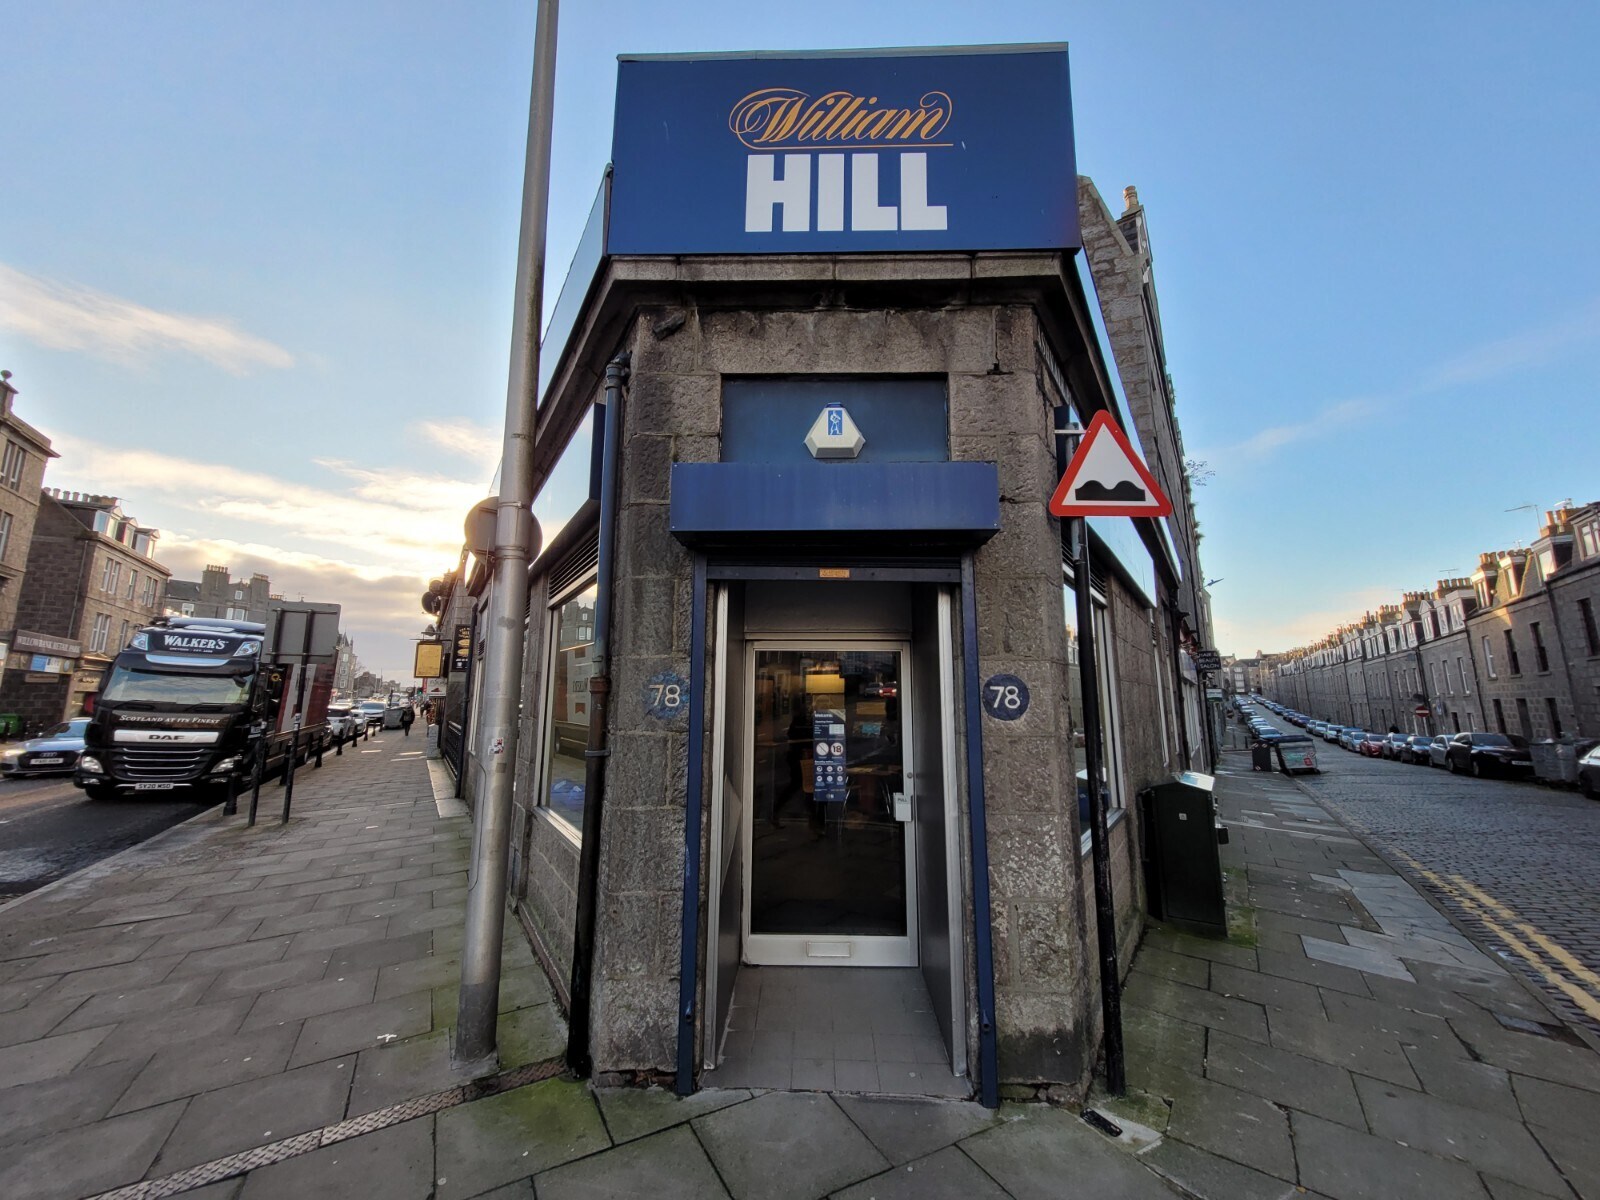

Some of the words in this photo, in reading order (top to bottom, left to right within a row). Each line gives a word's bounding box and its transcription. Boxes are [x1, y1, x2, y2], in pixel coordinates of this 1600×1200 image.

[729, 88, 954, 150] William
[745, 152, 948, 232] HILL
[649, 684, 680, 707] 78
[990, 685, 1021, 709] 78
[120, 714, 164, 722] SCOTLAND
